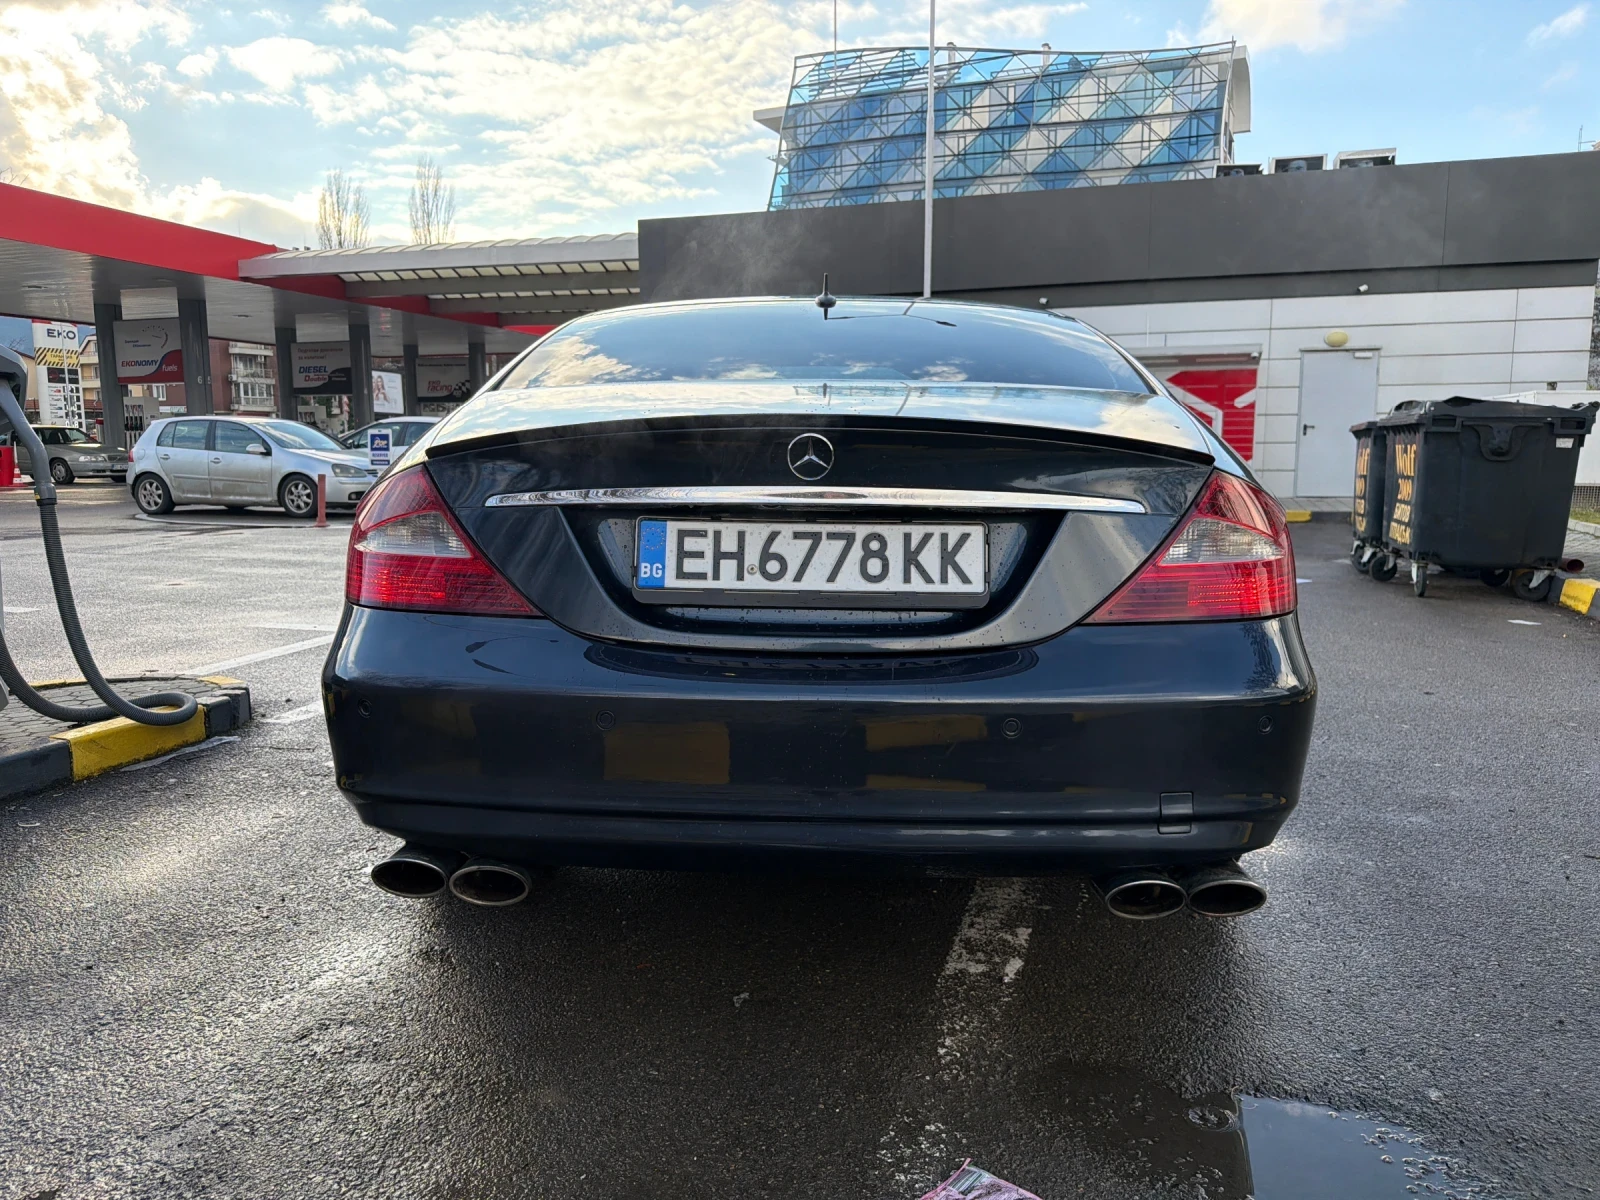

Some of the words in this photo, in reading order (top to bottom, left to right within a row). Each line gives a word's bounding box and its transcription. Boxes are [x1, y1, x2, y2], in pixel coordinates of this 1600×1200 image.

[46, 328, 76, 340] EKO
[121, 359, 159, 368] EKONOMY
[162, 364, 178, 372] fuels
[298, 365, 328, 374] DIESEL
[427, 384, 453, 393] racing
[1395, 444, 1416, 476] Wolf
[1397, 478, 1413, 501] 2009
[640, 563, 663, 578] BG
